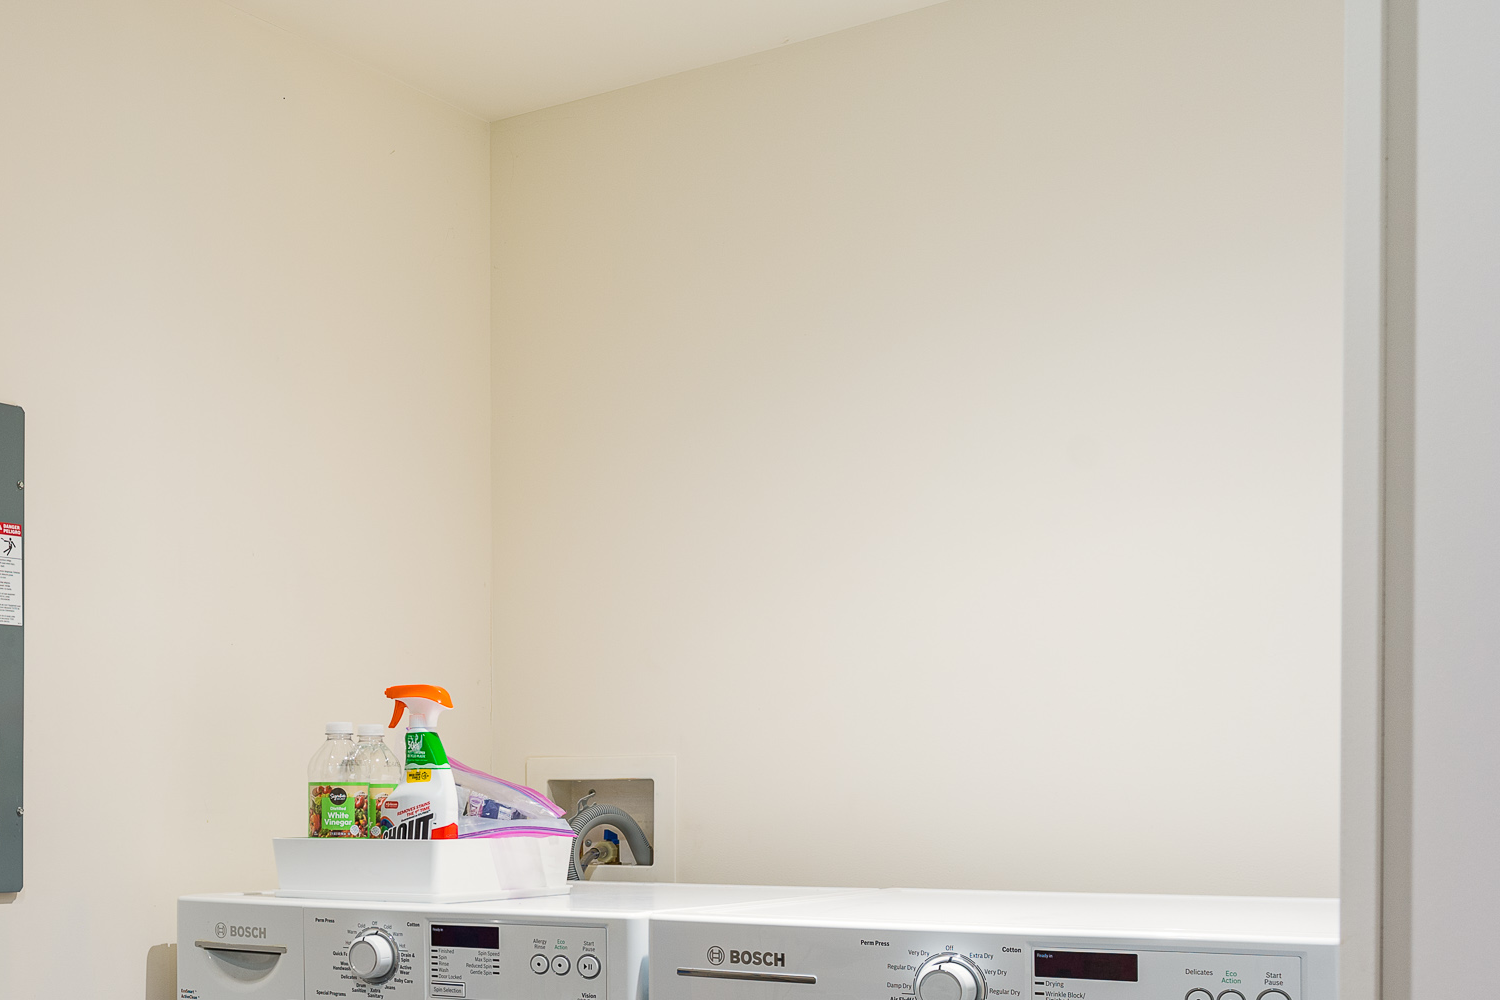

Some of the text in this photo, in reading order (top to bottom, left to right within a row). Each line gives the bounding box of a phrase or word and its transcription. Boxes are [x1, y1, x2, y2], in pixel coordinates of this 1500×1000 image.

[397, 806, 416, 816] REMOVES
[416, 801, 431, 810] STAINS
[324, 819, 352, 827] Vinegar
[230, 925, 267, 939] BOSCH
[729, 950, 785, 967] BOSCH
[1185, 968, 1213, 976] Delicates
[887, 982, 902, 990] Damp
[989, 988, 1010, 996] Regular
